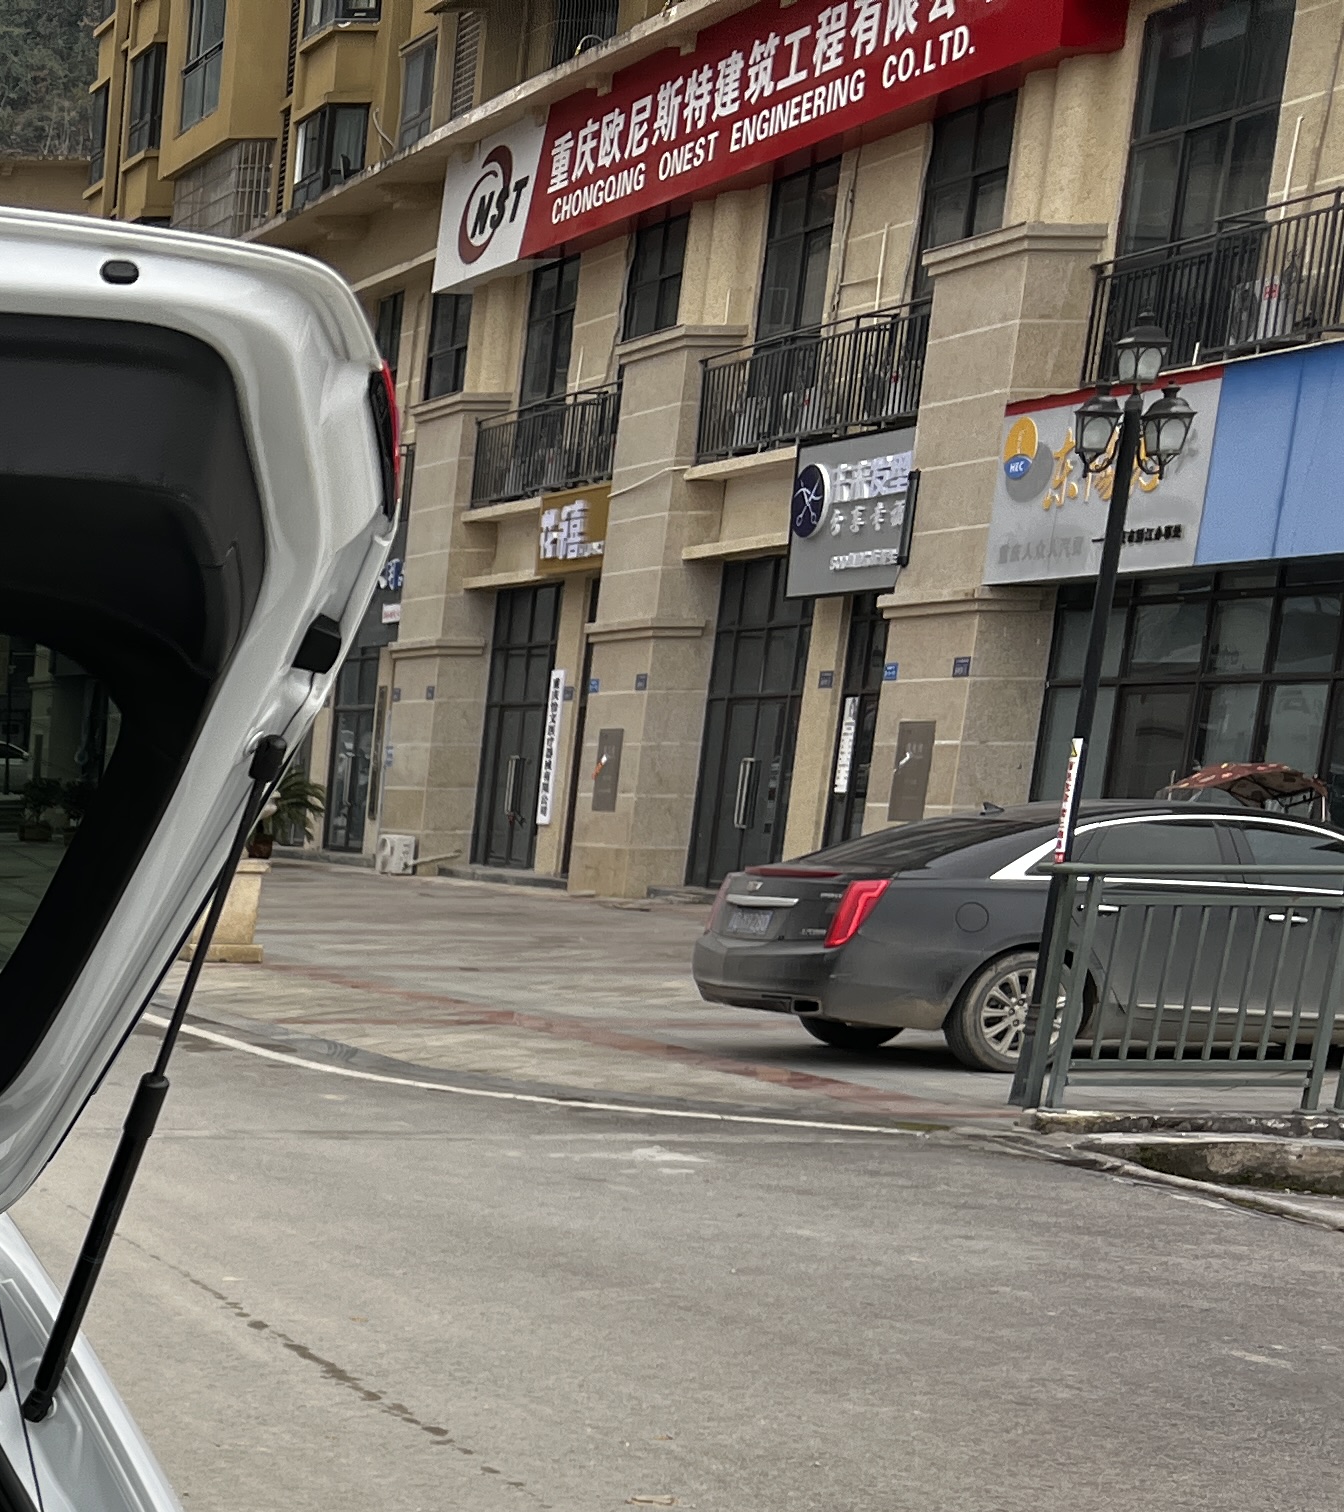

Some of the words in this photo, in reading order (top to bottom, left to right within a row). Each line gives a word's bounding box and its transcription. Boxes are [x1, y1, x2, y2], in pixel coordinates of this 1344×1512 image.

[547, 0, 993, 194] 重庆欧尼斯特建筑工程有限
[552, 163, 647, 225] CHONGQING
[658, 131, 720, 181] ONEST
[729, 69, 866, 153] ENGINEERING
[882, 25, 976, 89] CO.LTD.
